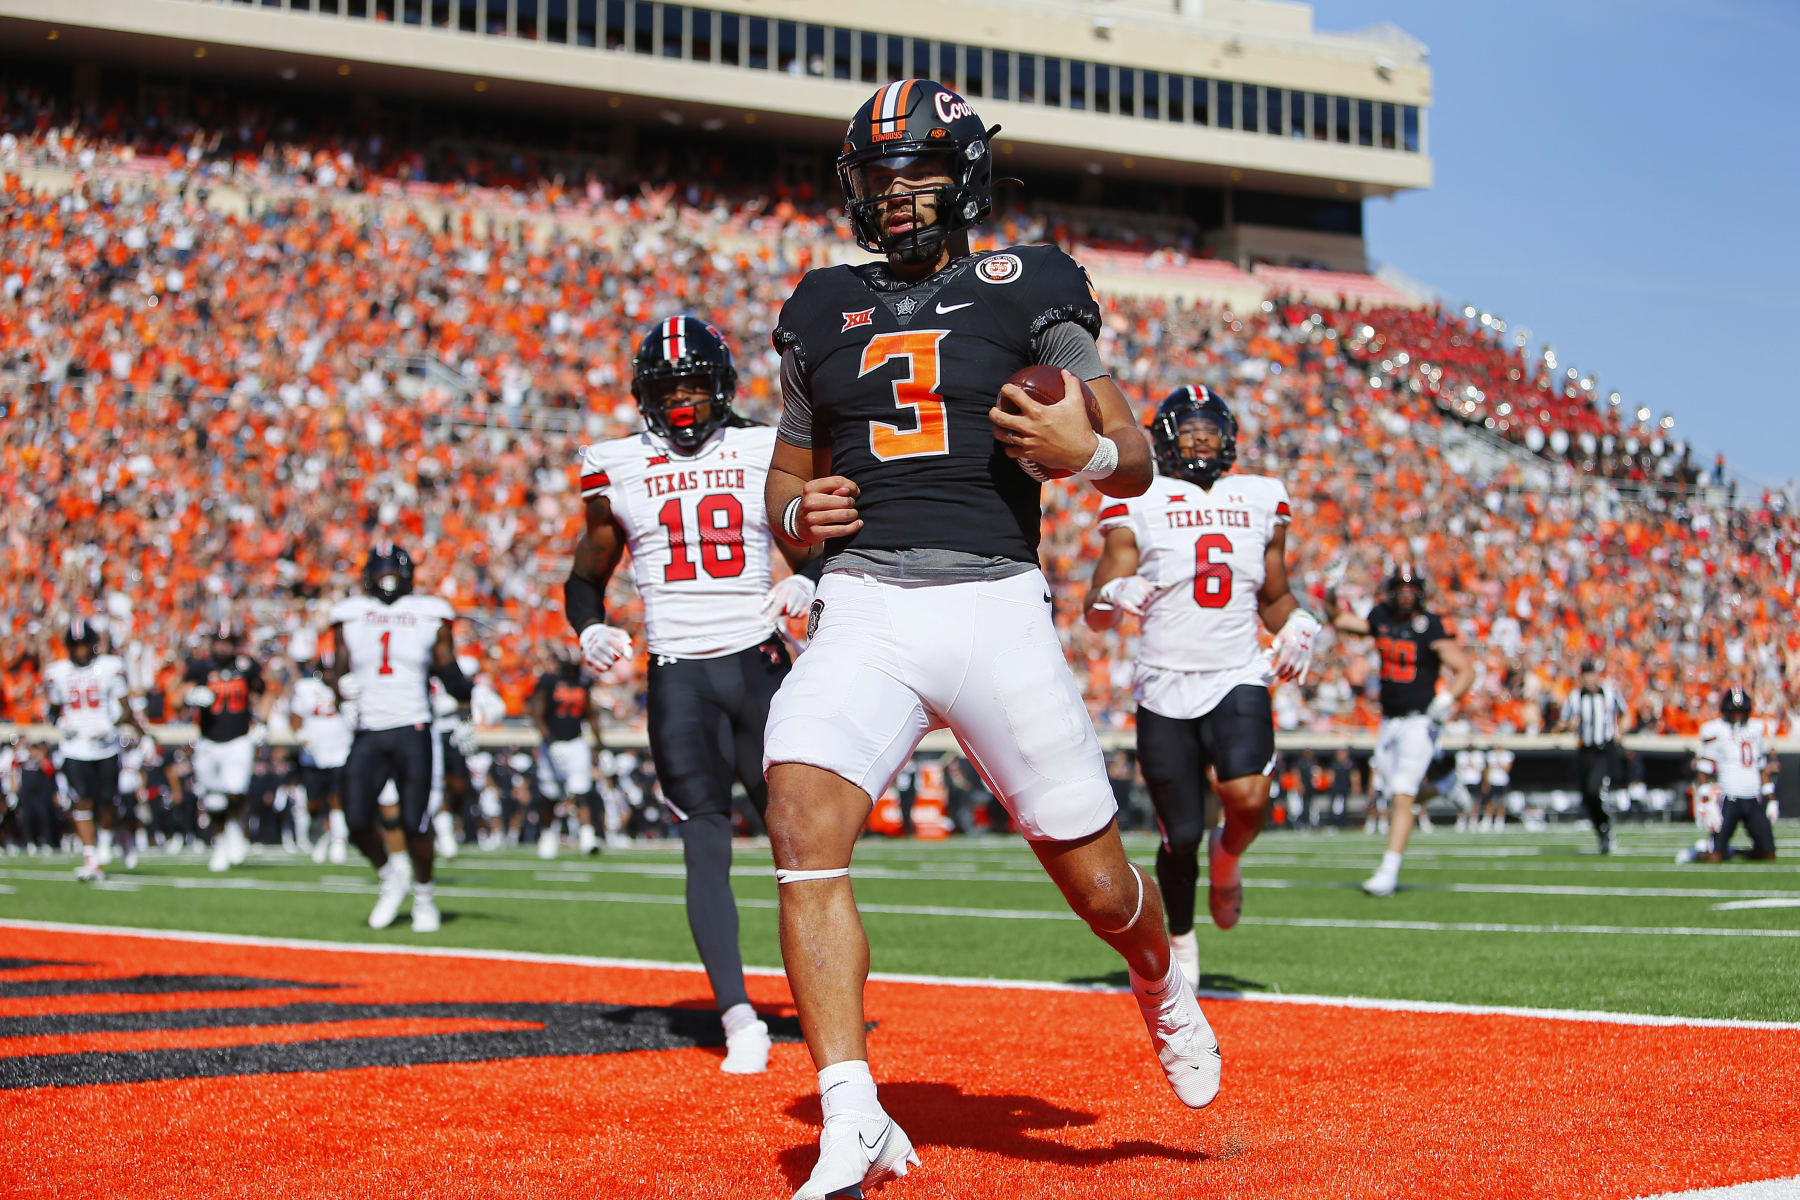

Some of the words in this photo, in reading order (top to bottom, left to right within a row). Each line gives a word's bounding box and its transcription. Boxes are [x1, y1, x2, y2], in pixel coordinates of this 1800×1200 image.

[872, 130, 903, 143] COWBOYS
[857, 330, 951, 462] 3
[644, 470, 698, 498] TEXAS
[703, 469, 745, 489] TECH
[1165, 509, 1213, 529] TEXAS
[1217, 508, 1251, 528] TECH
[658, 494, 745, 583] 18
[1193, 533, 1233, 608] 6
[378, 631, 393, 675] 1
[1741, 740, 1754, 768] 0
